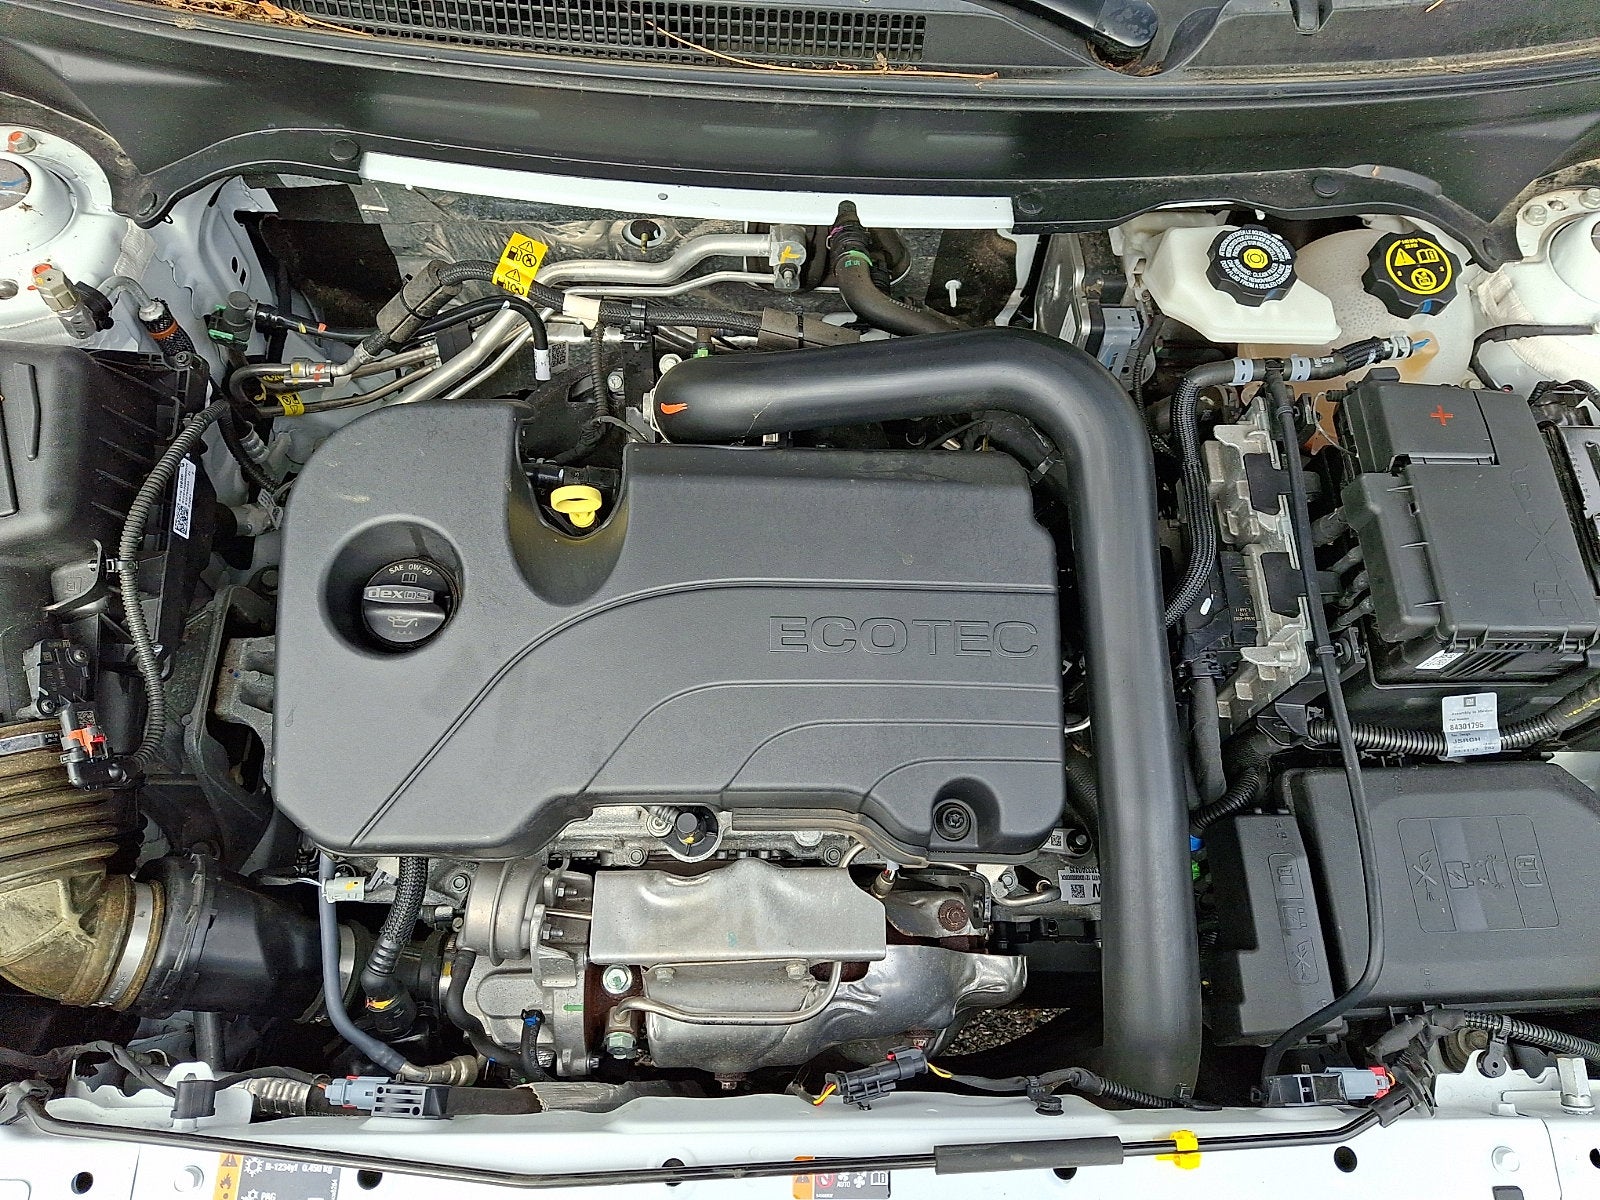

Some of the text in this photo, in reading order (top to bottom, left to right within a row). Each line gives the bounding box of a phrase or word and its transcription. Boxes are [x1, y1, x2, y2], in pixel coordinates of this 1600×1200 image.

[1240, 280, 1254, 288] FROM
[388, 563, 433, 576] SAE 0W-20
[368, 588, 428, 600] dexos
[769, 616, 1038, 659] ECOTEC
[1450, 721, 1484, 730] 84301795
